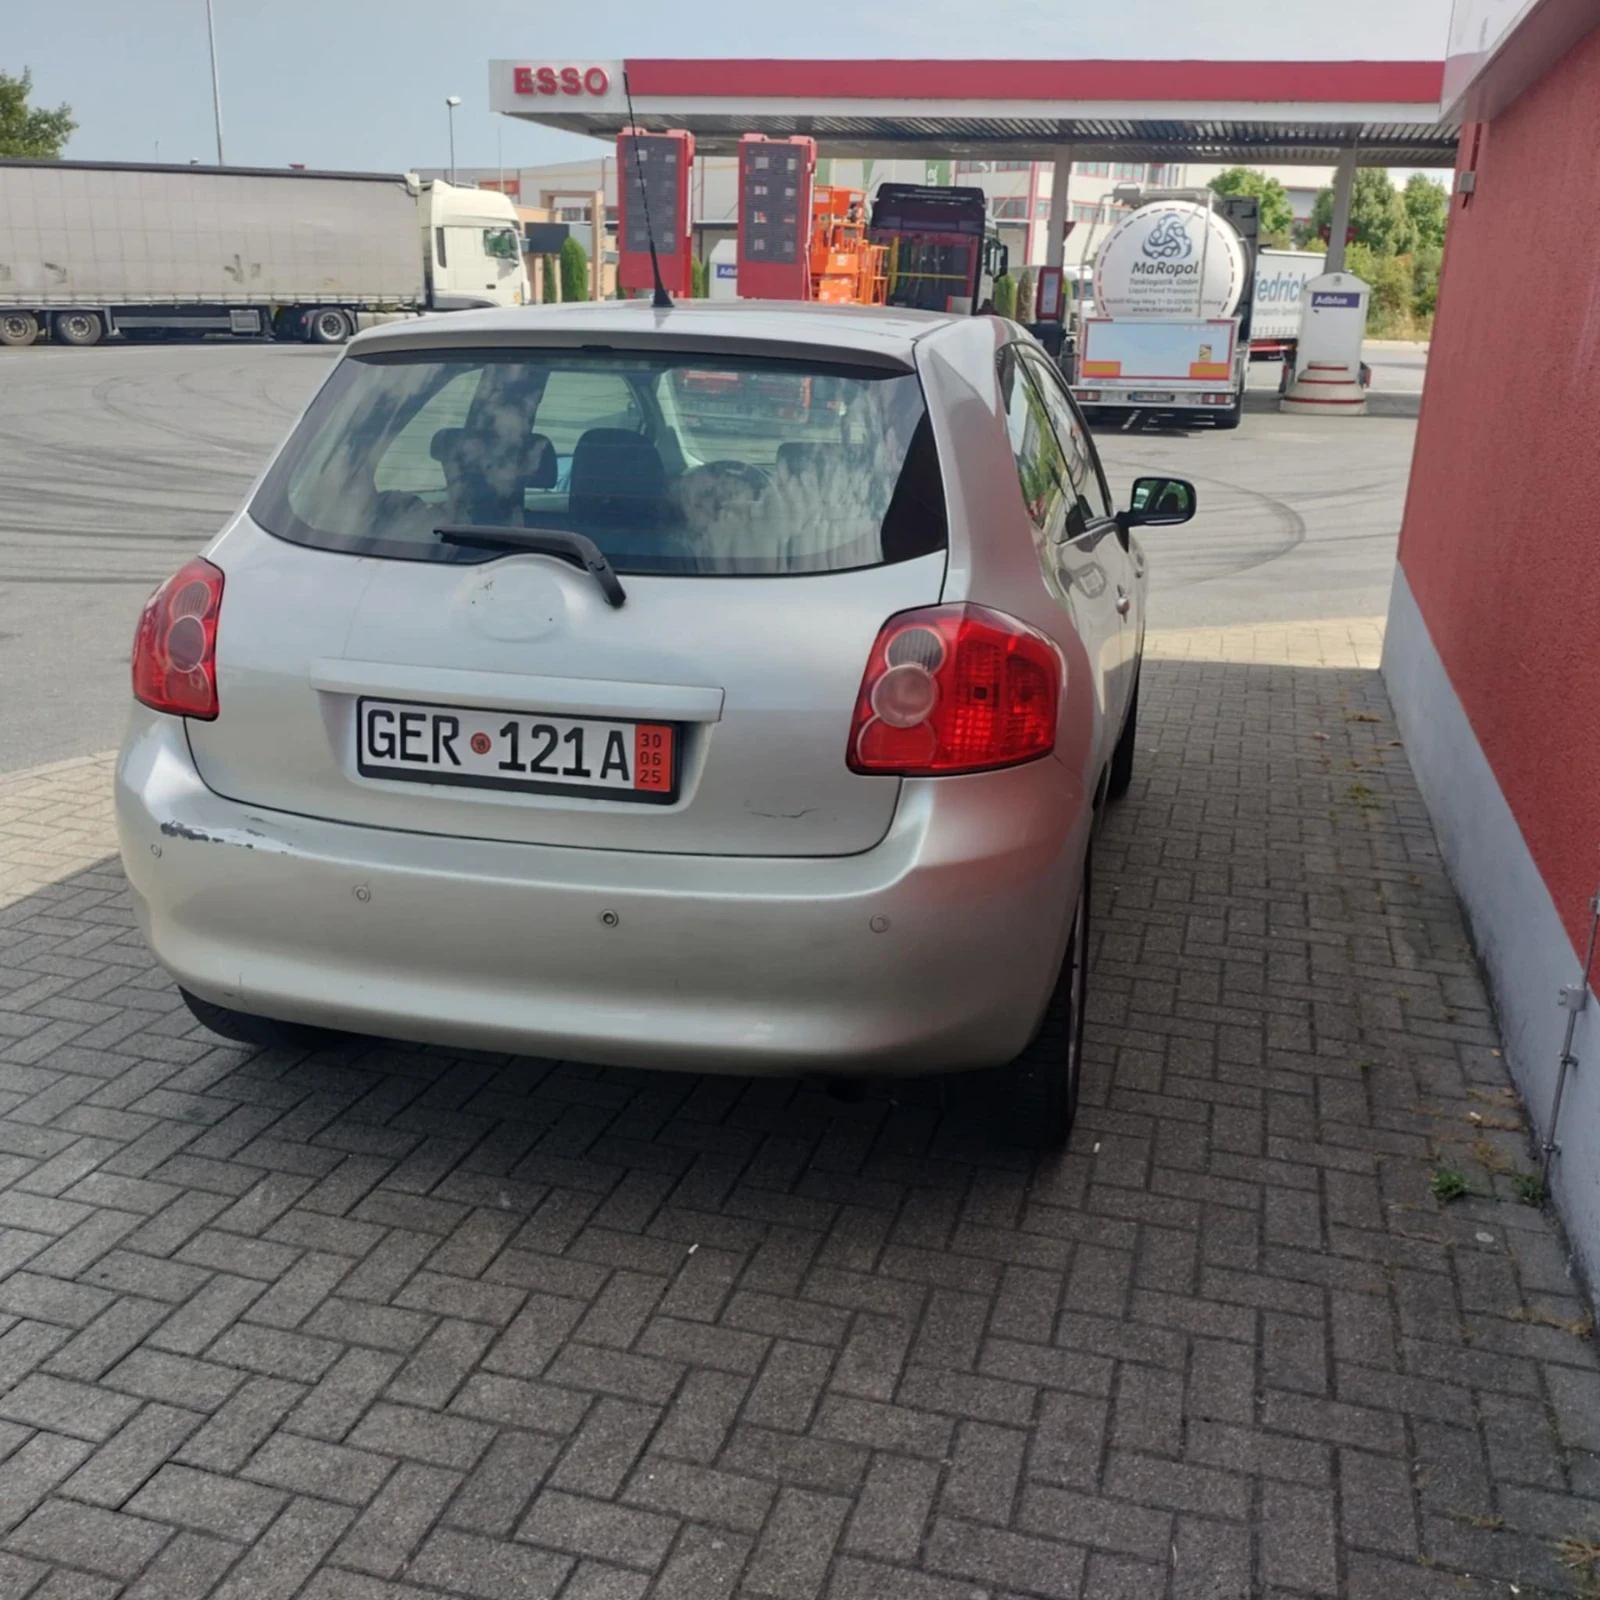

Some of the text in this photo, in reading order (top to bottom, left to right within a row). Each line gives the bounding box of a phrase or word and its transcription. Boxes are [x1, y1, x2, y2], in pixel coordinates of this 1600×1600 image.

[513, 66, 609, 96] ESSO
[1131, 261, 1199, 277] MaRopol
[1176, 278, 1199, 286] GmbH
[367, 709, 462, 766] GER
[640, 733, 662, 748] 30
[640, 751, 662, 766] 06
[639, 769, 661, 784] 25
